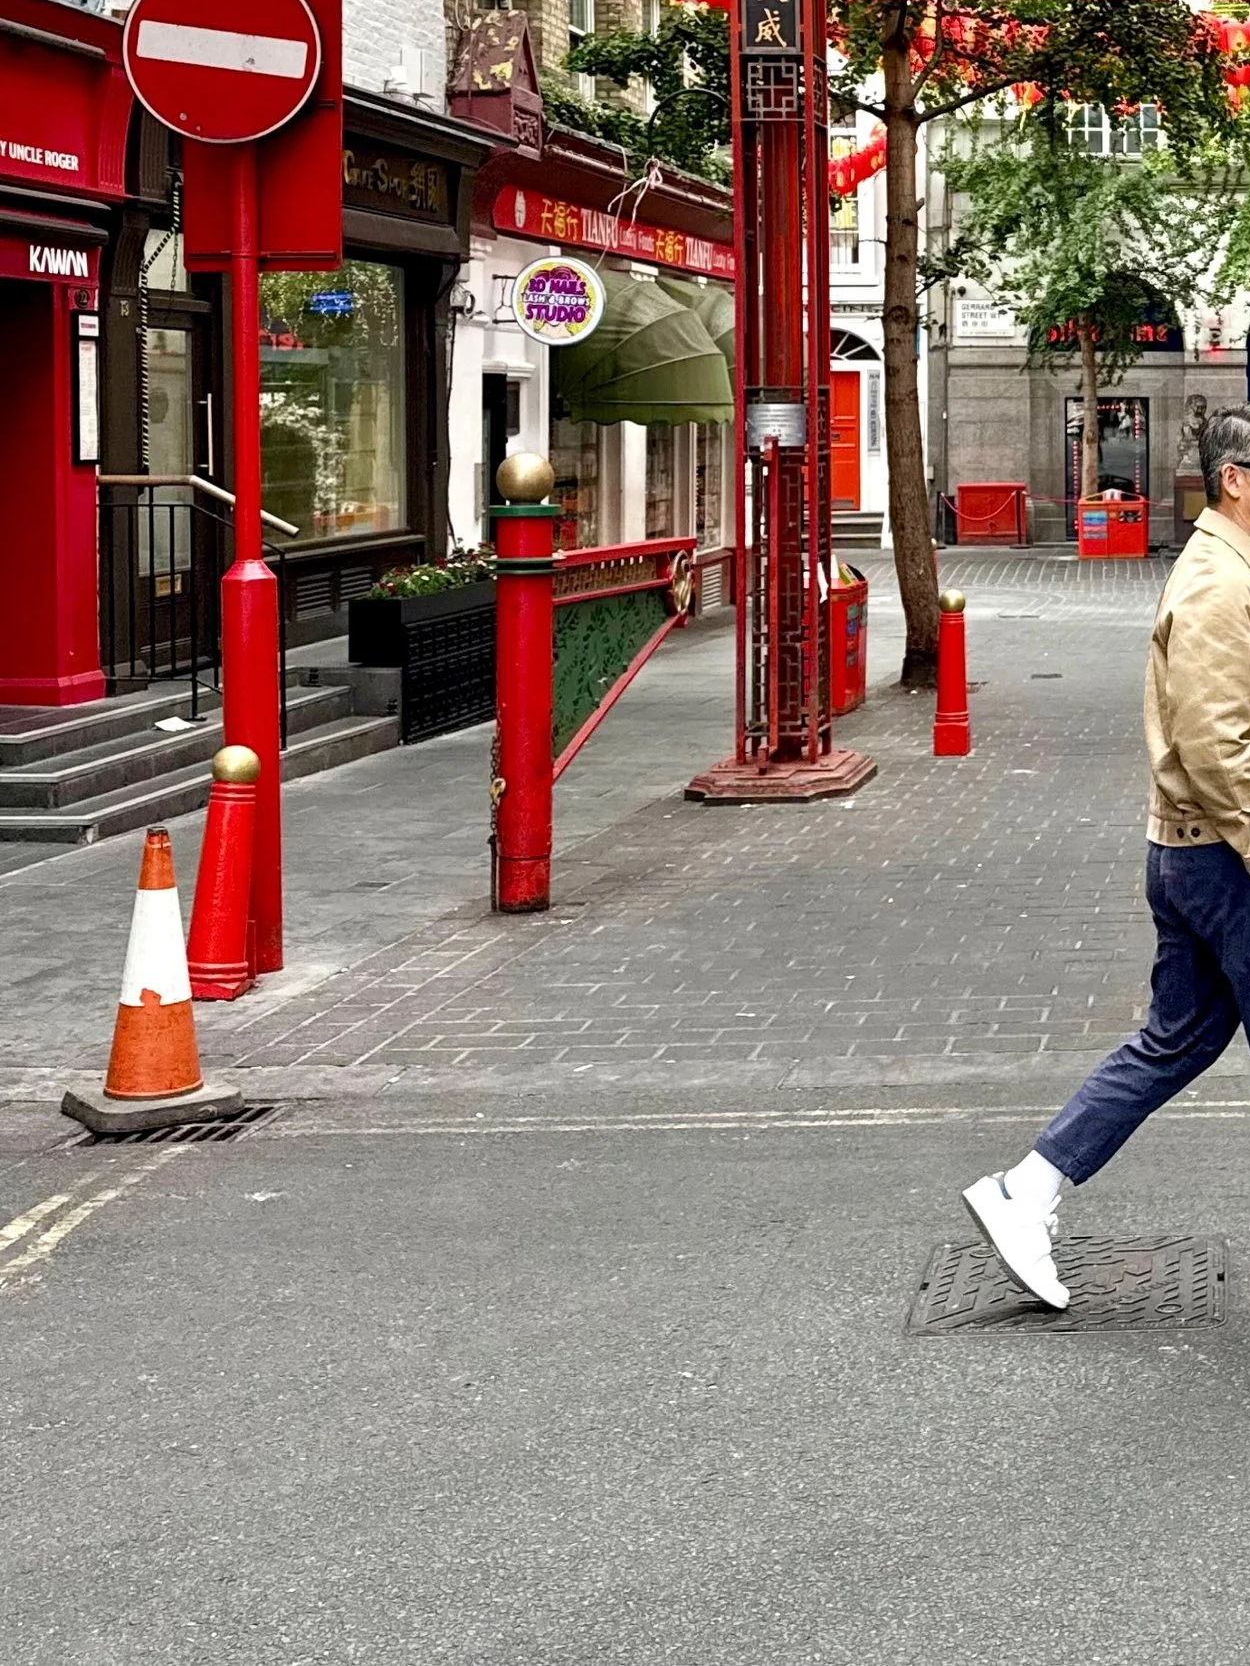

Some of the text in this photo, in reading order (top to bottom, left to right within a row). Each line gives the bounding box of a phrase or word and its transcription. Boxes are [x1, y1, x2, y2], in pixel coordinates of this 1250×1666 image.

[0, 140, 79, 172] Y UNCLE ROGER
[581, 208, 619, 249] TIANFU
[685, 236, 714, 271] TIANFU
[29, 244, 89, 278] KAWAN
[523, 293, 546, 303] LASH
[559, 295, 590, 305] BROWS
[525, 303, 587, 323] STUDIO
